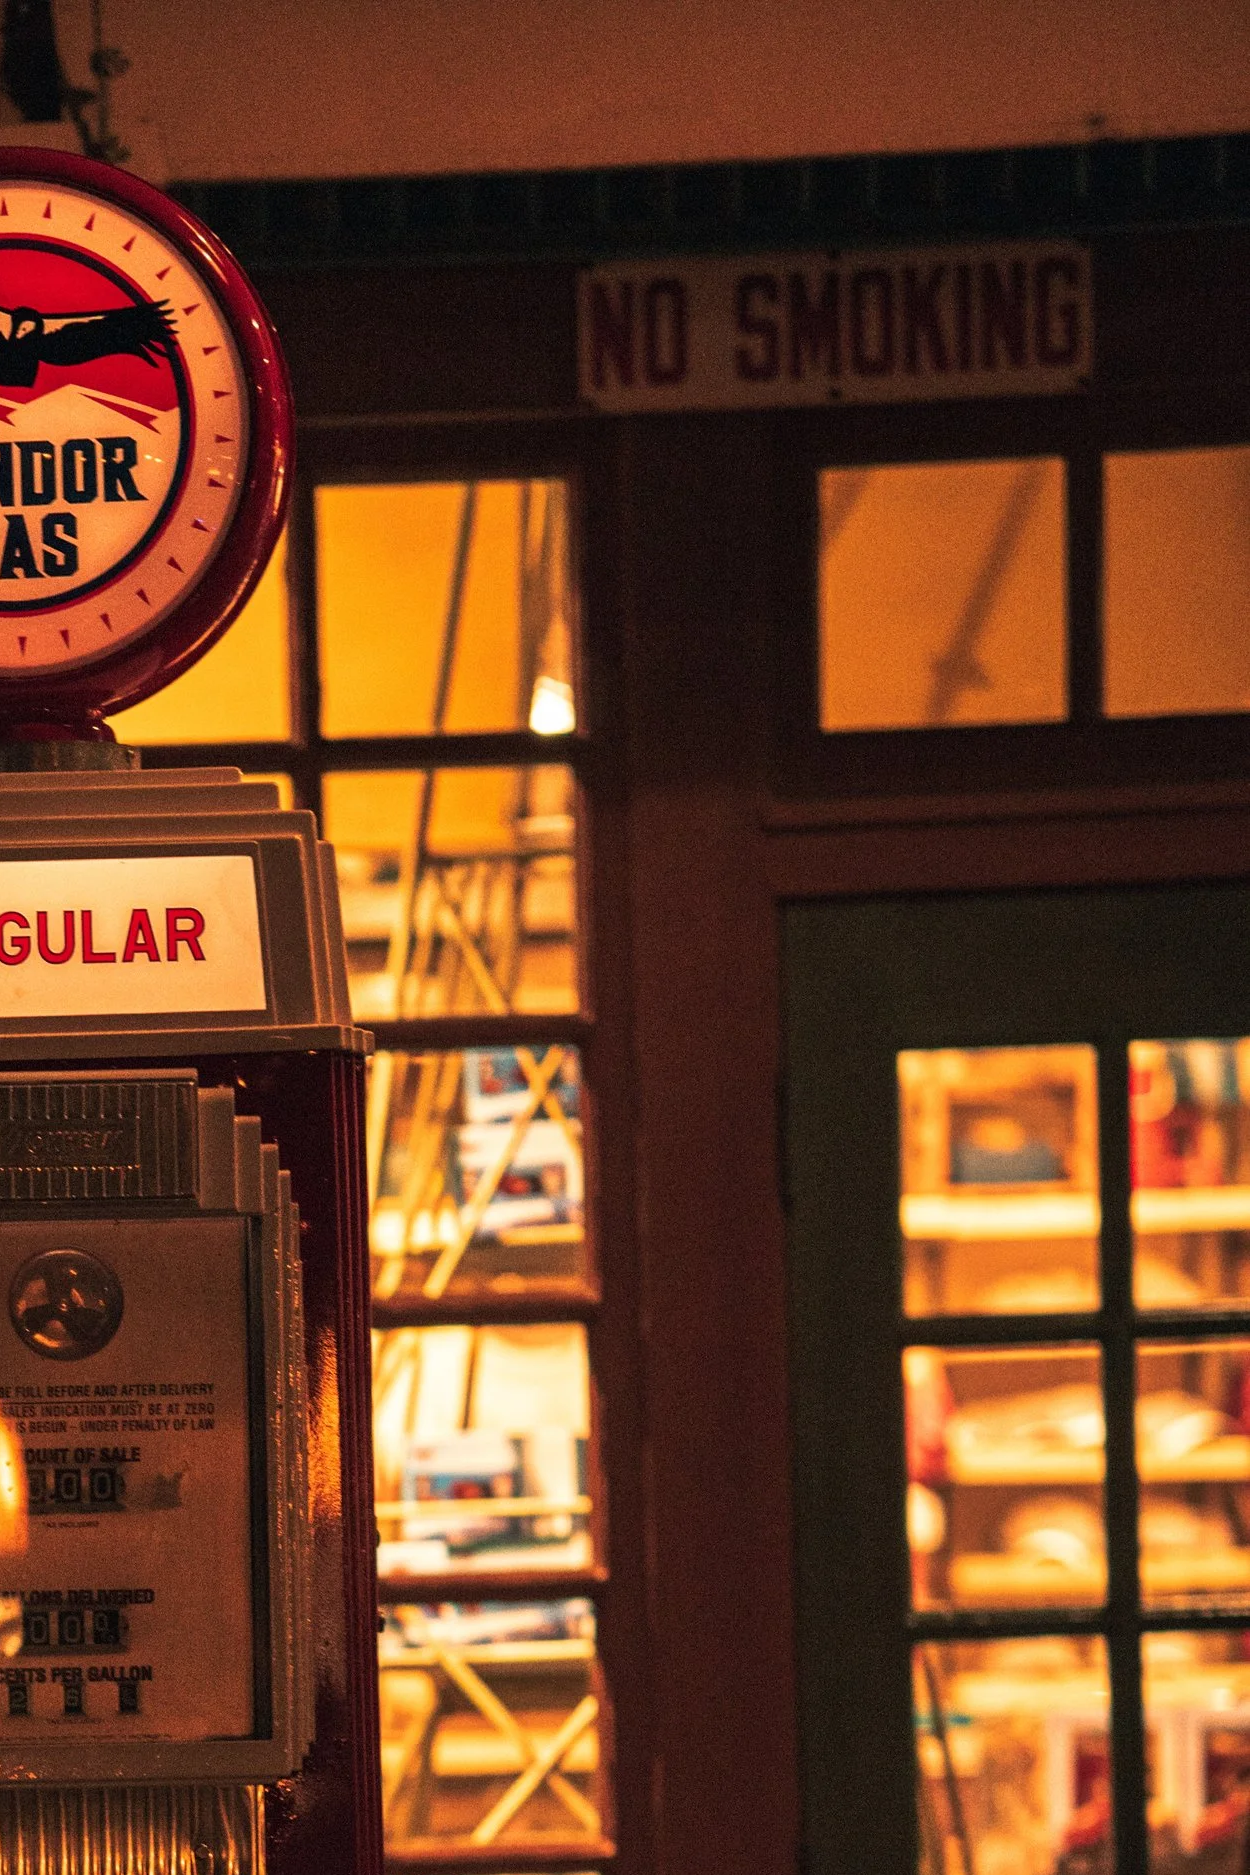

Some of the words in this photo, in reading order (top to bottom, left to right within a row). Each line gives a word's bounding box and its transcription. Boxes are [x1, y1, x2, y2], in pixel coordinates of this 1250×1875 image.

[589, 277, 688, 389] NO
[733, 257, 1081, 384] SMOKING
[15, 1385, 42, 1399] FULL
[46, 1384, 90, 1398] BEFORE
[93, 1384, 117, 1397] AND
[120, 1383, 156, 1397] AFTER
[159, 1383, 214, 1396] DELIVERY
[41, 1404, 106, 1418] INDICATION
[110, 1403, 143, 1416] MUST
[148, 1402, 161, 1416] BE
[167, 1402, 180, 1415] AT
[185, 1402, 215, 1416] ZERO
[29, 1419, 67, 1433] BEGUN
[79, 1420, 119, 1432] UNDER
[121, 1418, 169, 1431] PENALTY
[172, 1418, 187, 1431] OF
[190, 1418, 215, 1431] LAW
[24, 1447, 69, 1463] OUNT
[74, 1447, 95, 1463] OF
[100, 1446, 141, 1462] SALE
[67, 1588, 155, 1604] DELIVERED
[51, 1666, 83, 1683] PER
[87, 1665, 153, 1682] GALLON
